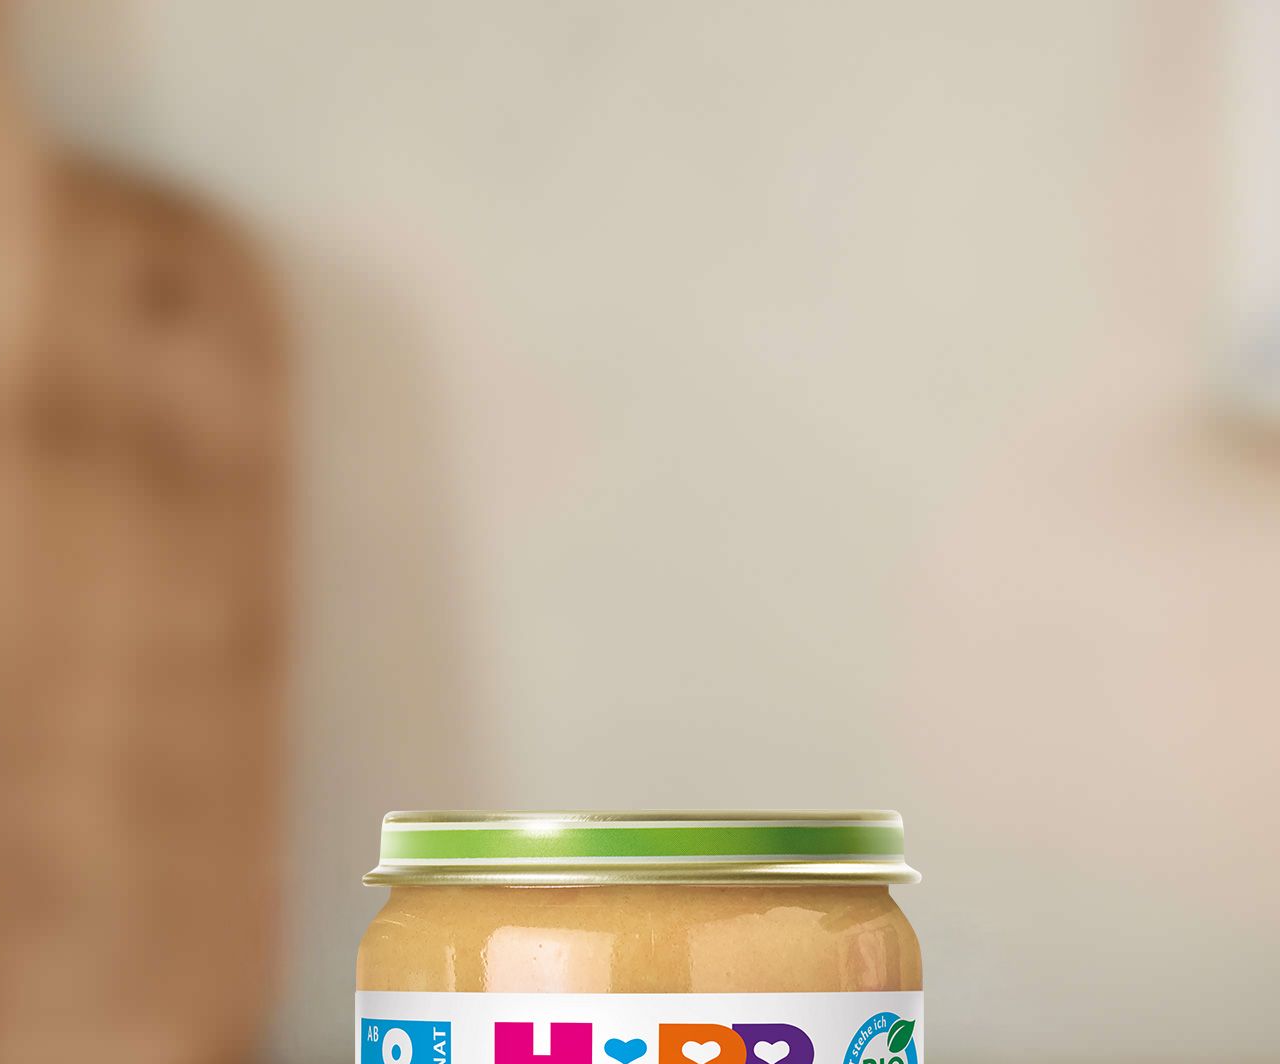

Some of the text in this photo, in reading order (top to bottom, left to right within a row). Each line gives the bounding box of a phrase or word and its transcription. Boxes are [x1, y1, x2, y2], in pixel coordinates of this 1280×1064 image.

[367, 1025, 379, 1042] AB
[851, 1026, 873, 1057] stehe
[873, 1015, 887, 1031] ich
